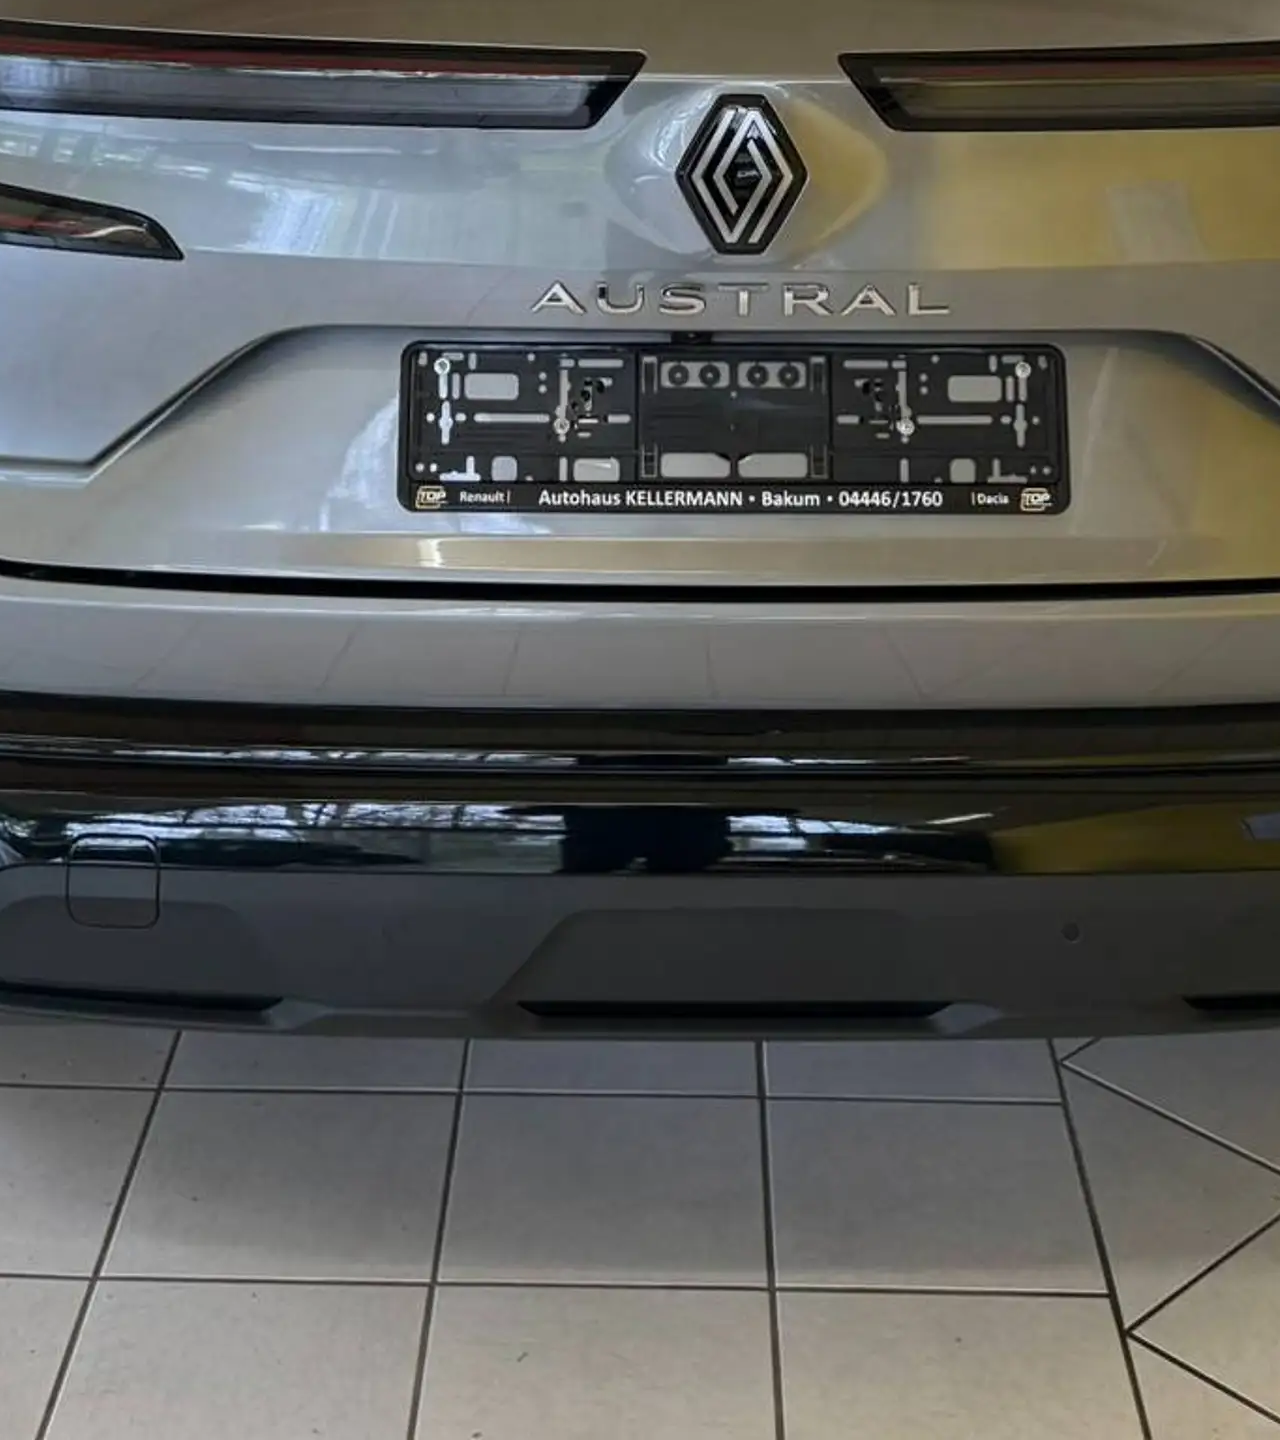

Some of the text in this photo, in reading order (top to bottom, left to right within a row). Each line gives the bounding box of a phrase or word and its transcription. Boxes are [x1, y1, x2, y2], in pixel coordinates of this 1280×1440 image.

[530, 279, 951, 317] AUSTRAL
[418, 489, 1052, 508] TOP Renault Autohaus KELLERMANN Bakum 04446/1760 Dacia TOP
